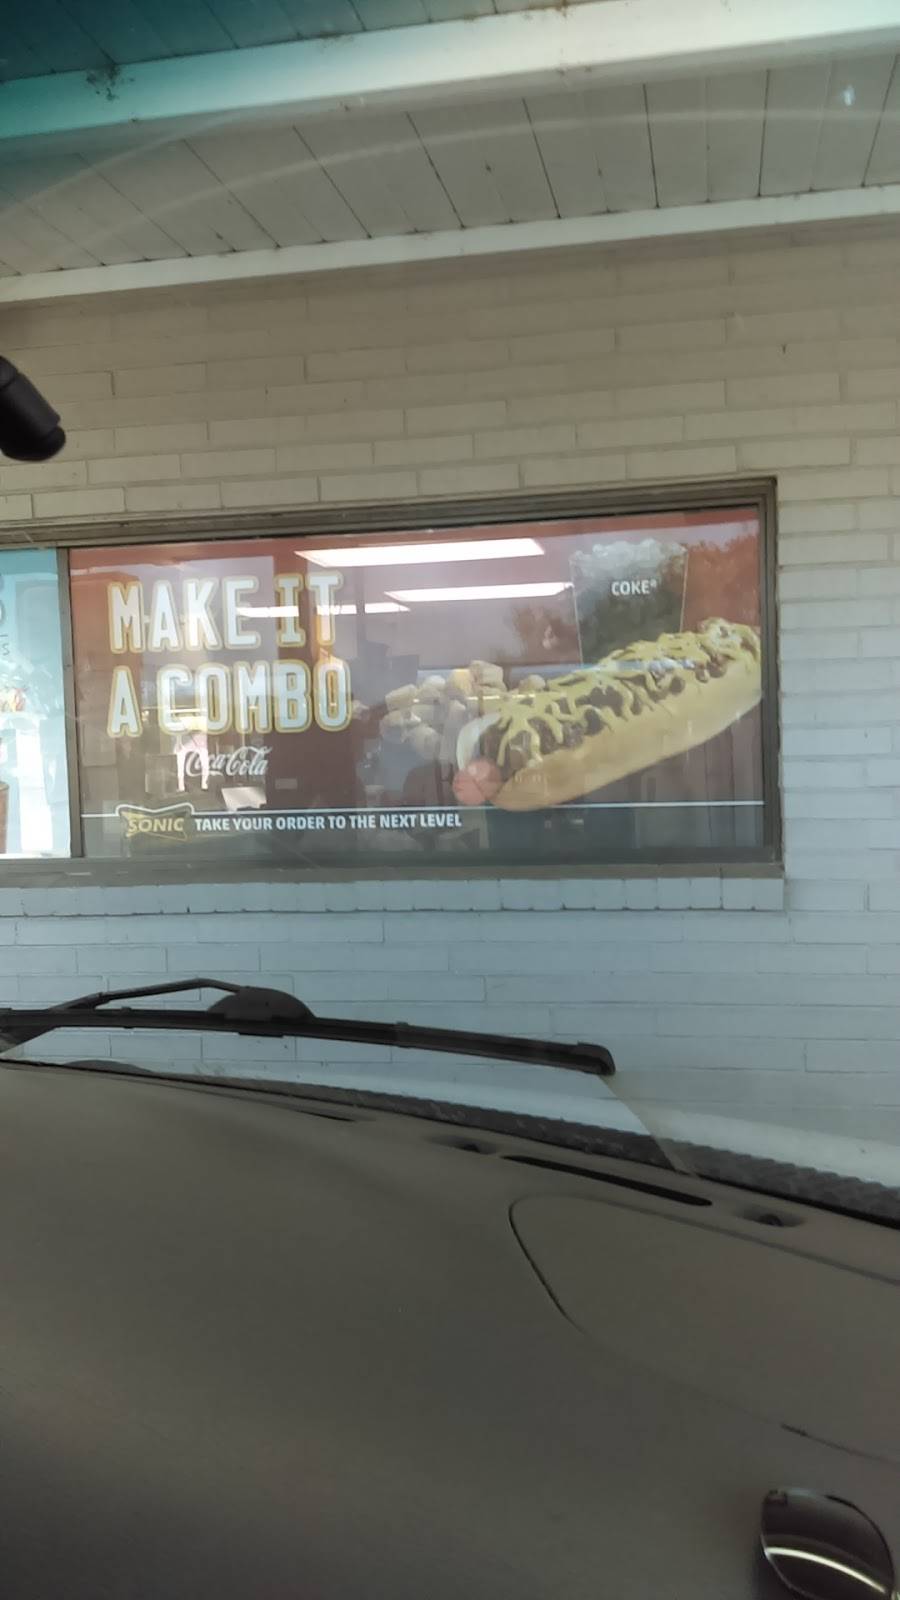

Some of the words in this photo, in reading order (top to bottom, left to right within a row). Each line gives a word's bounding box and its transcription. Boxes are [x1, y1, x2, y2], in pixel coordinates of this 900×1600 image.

[108, 577, 260, 653] MAKE
[274, 571, 343, 647] IT
[107, 666, 142, 737] A
[157, 659, 351, 735] COMBO
[127, 818, 184, 832] SONIC
[194, 818, 230, 831] TAKE
[232, 817, 273, 831] YOUR
[275, 816, 325, 830] ORDER
[328, 815, 346, 828] TO
[349, 814, 376, 828] THE
[380, 813, 417, 827] NEXT
[420, 813, 462, 826] LEVEL
